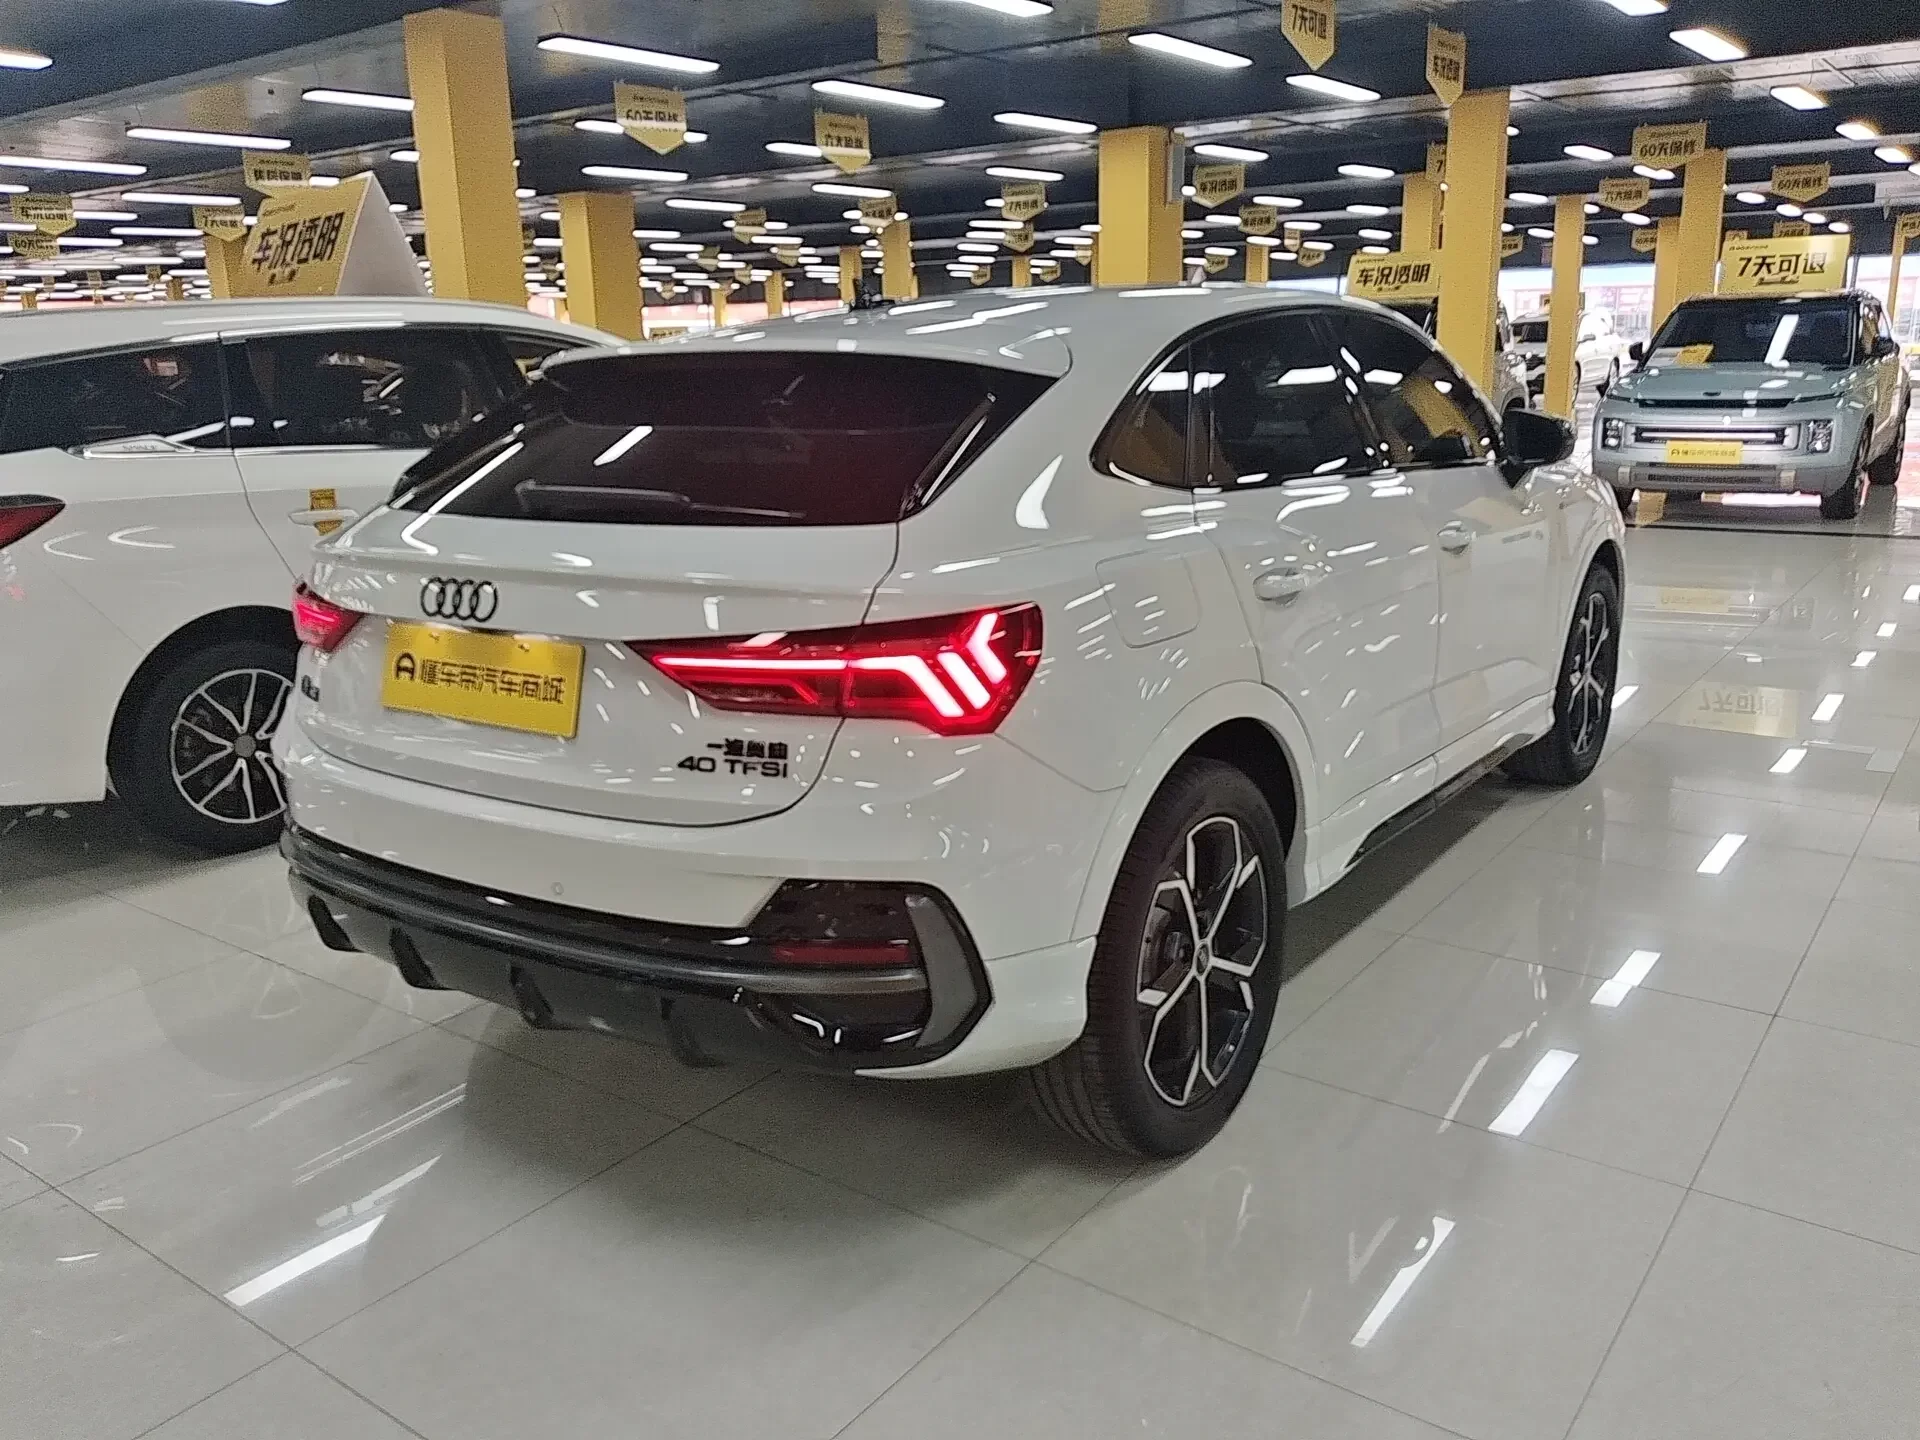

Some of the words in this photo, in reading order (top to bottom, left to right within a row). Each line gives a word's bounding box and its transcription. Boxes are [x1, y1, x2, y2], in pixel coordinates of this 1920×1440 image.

[1292, 4, 1327, 39] 7天可退
[251, 211, 346, 270] 车况透明
[1355, 263, 1431, 287] 车况透明
[1737, 252, 1828, 277] 7天可退
[421, 659, 566, 704] 懂车帝汽车商城
[677, 756, 716, 773] 40
[723, 758, 788, 778] TFSI
